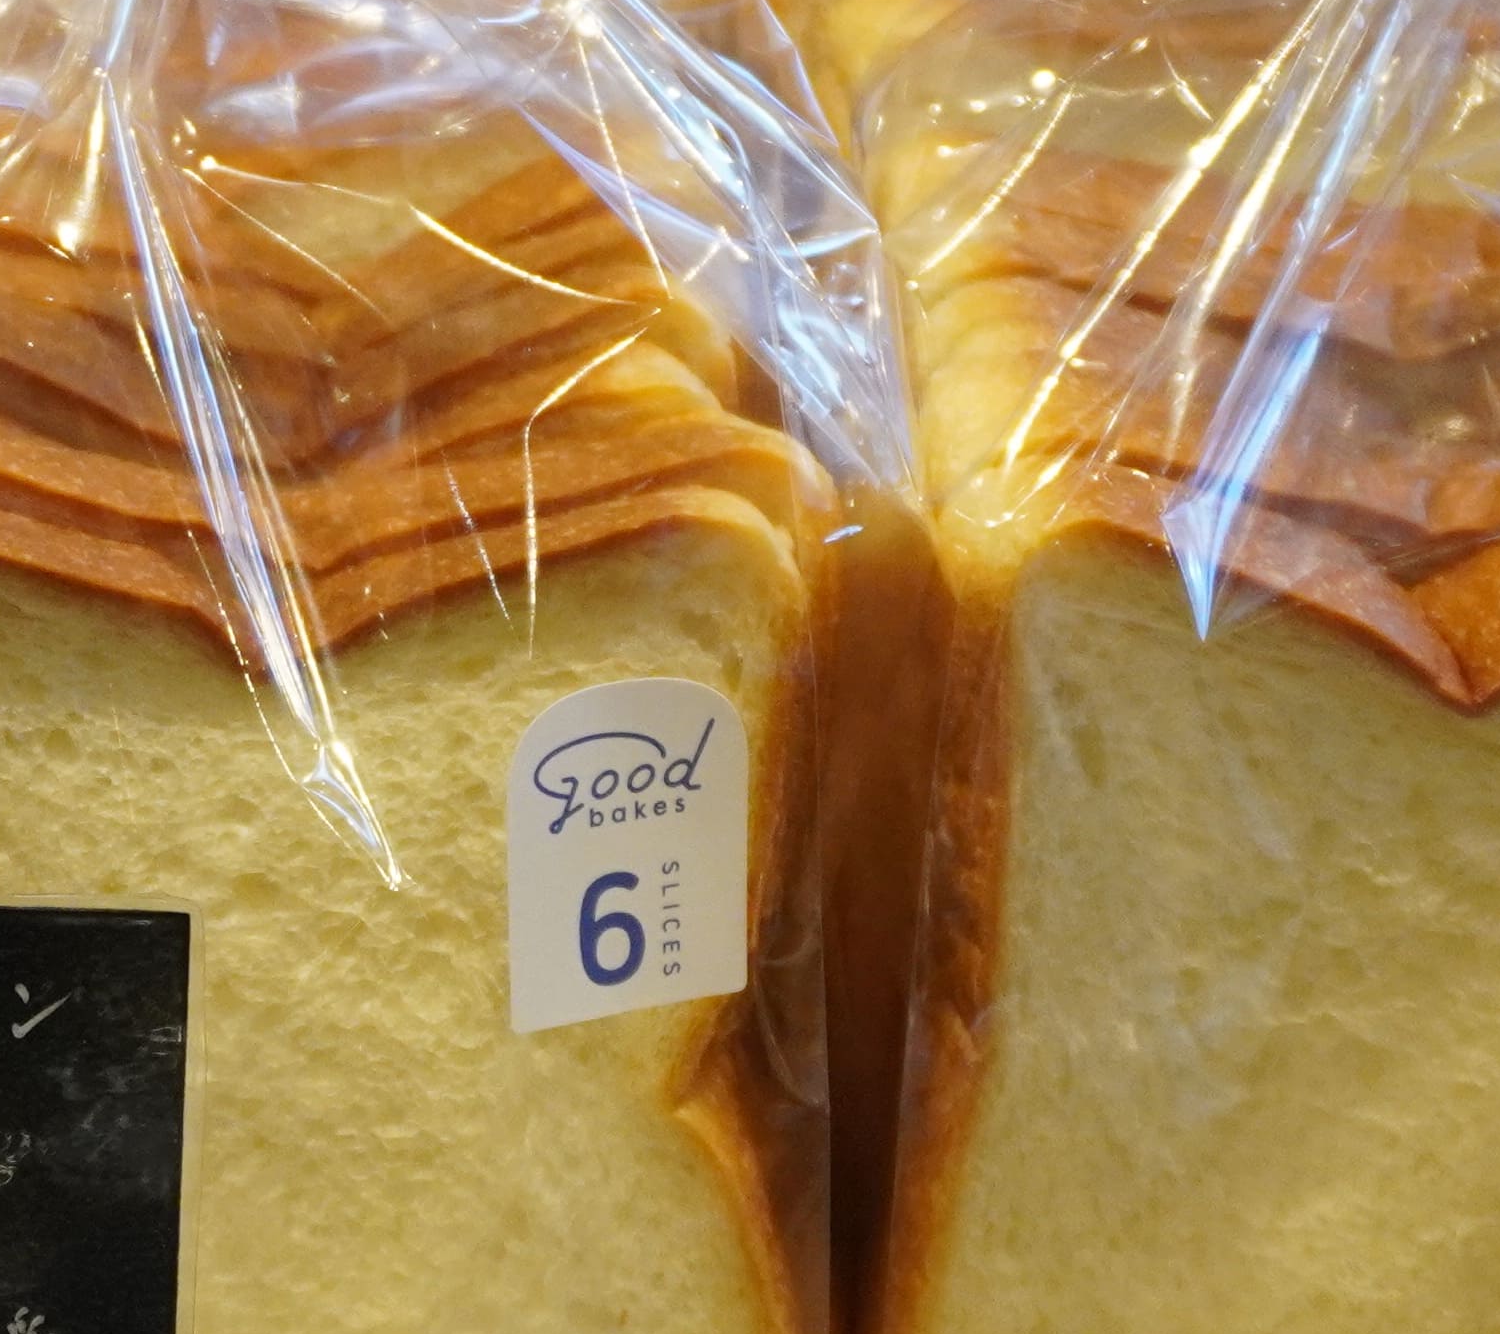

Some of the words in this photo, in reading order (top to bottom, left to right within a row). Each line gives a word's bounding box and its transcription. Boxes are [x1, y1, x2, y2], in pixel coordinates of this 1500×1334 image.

[589, 796, 686, 828] bakes
[580, 871, 646, 987] 6
[661, 860, 681, 977] SLICES
